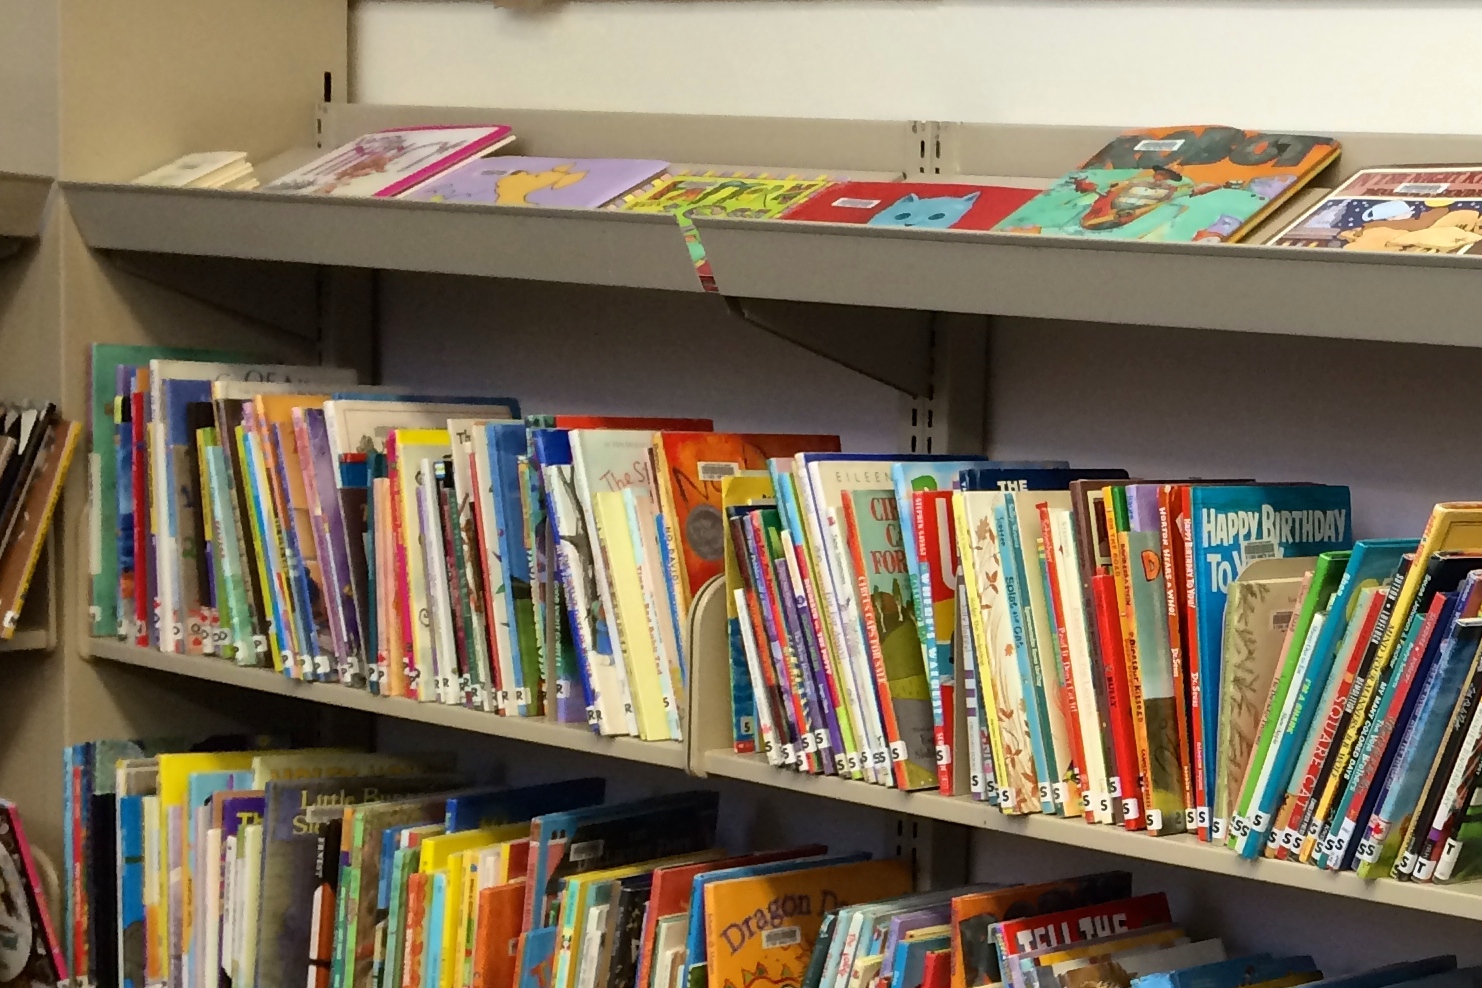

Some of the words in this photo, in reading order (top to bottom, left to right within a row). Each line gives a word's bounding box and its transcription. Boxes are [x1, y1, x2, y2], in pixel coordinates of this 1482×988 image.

[1202, 507, 1259, 548] HAPPY
[1261, 504, 1347, 546] BIRTHDAY
[1206, 552, 1233, 594] TO
[1388, 574, 1404, 600] SUTTON
[858, 576, 872, 611] CIRCUS
[864, 612, 876, 636] CAPS
[868, 638, 880, 658] FOR
[872, 660, 887, 686] SALE
[1344, 677, 1365, 713] DEMOLITION
[1368, 696, 1382, 719] MANY
[1306, 695, 1347, 767] SQUARE
[1353, 720, 1373, 757] COLORED
[1342, 758, 1357, 780] DAYS
[1294, 775, 1316, 813] CAT
[1252, 813, 1263, 827] S
[1444, 842, 1456, 856] T
[720, 896, 813, 956] Dragon
